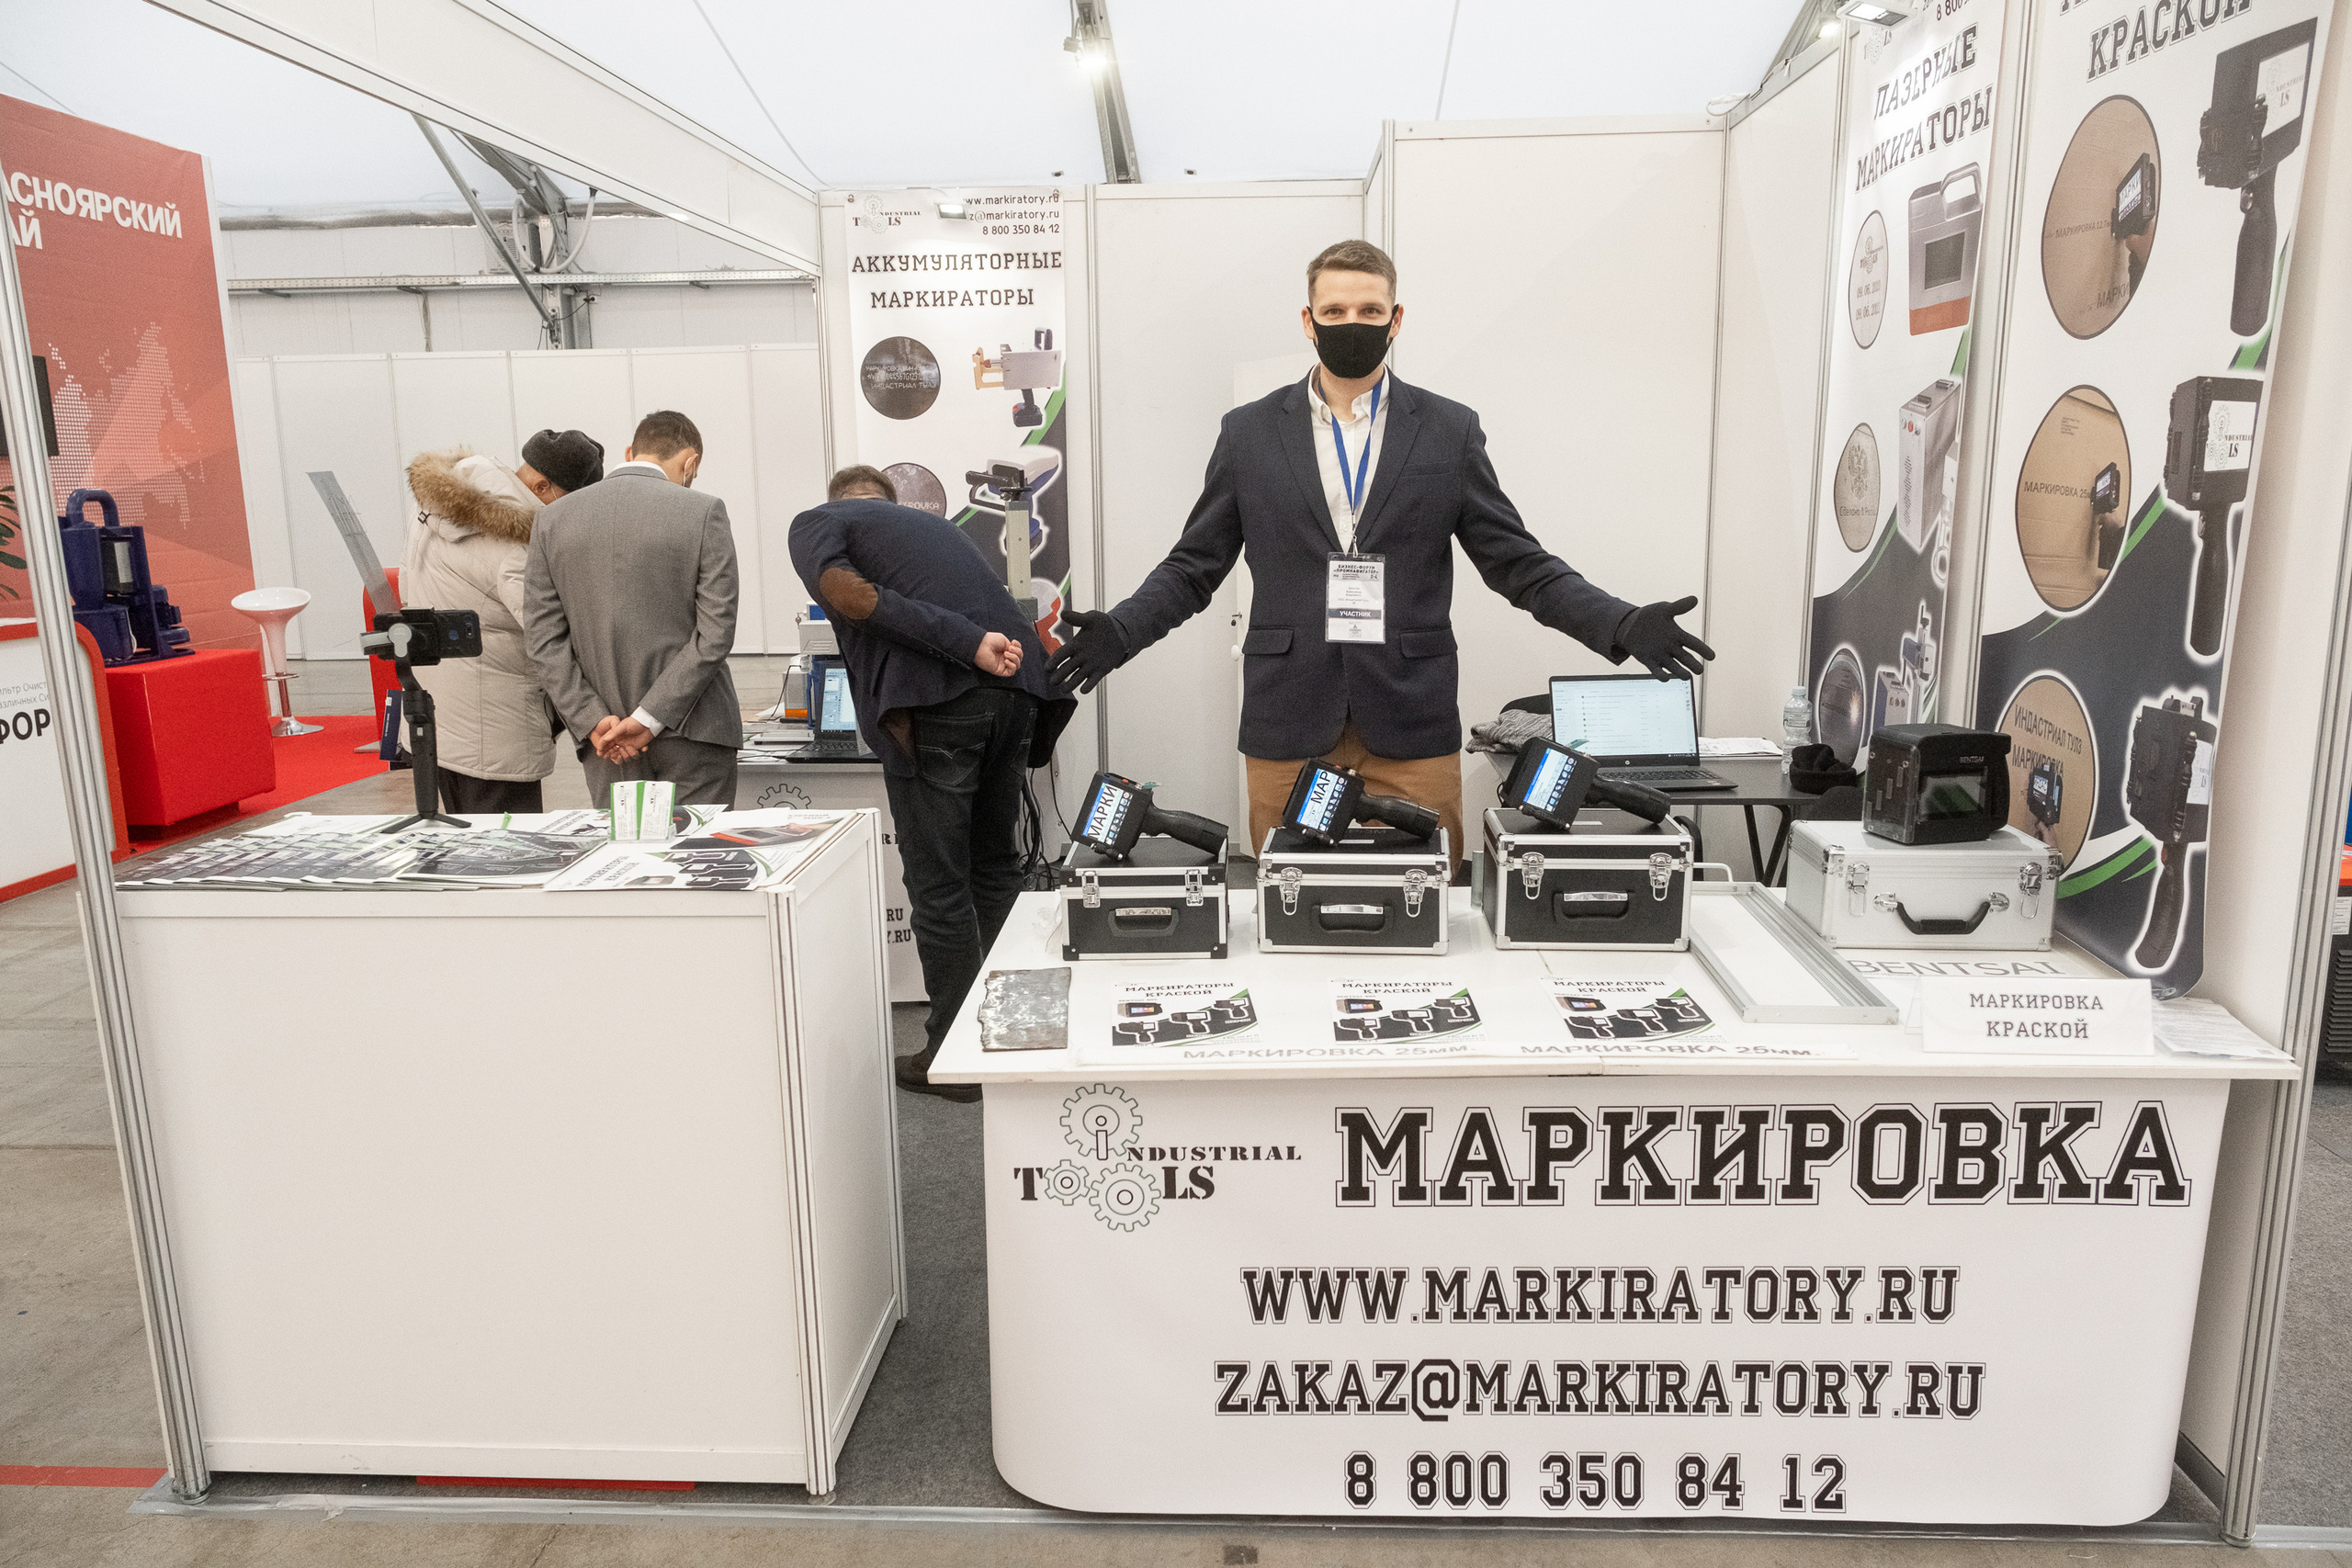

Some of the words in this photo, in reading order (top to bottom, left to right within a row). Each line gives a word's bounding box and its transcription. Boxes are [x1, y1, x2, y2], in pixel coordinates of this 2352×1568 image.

[1855, 84, 1993, 193] МАРКИРАТОРЫ
[964, 194, 1059, 206] ww.markiratory.ru
[982, 226, 989, 235] 8
[991, 226, 1010, 235] 800
[1012, 225, 1030, 234] 350
[1034, 225, 1046, 234] 84
[1048, 224, 1060, 233] 12
[852, 252, 1062, 273] АККУМУЛЯТОРНЫЕ
[871, 288, 1034, 309] МАРКИРАТОРЫ
[1970, 993, 2104, 1010] МАРКИРОВКА
[1986, 1018, 2088, 1039] КРАСКОЙ
[1183, 1048, 1385, 1058] МАРКИРОВКА
[1521, 1044, 1727, 1055] МАРКИРОВКА
[1335, 1100, 2192, 1208] МАРКИРОВКА
[1240, 1266, 1961, 1325] WWW.MARKIRATORY.RU
[1214, 1359, 1986, 1421] ZAKAZ@MARKIRATORY.RU
[1343, 1450, 1377, 1510] 8
[1407, 1450, 1510, 1511] 800
[1539, 1451, 1645, 1512] 350
[1675, 1452, 1745, 1512] 84
[1781, 1453, 1847, 1514] 12
